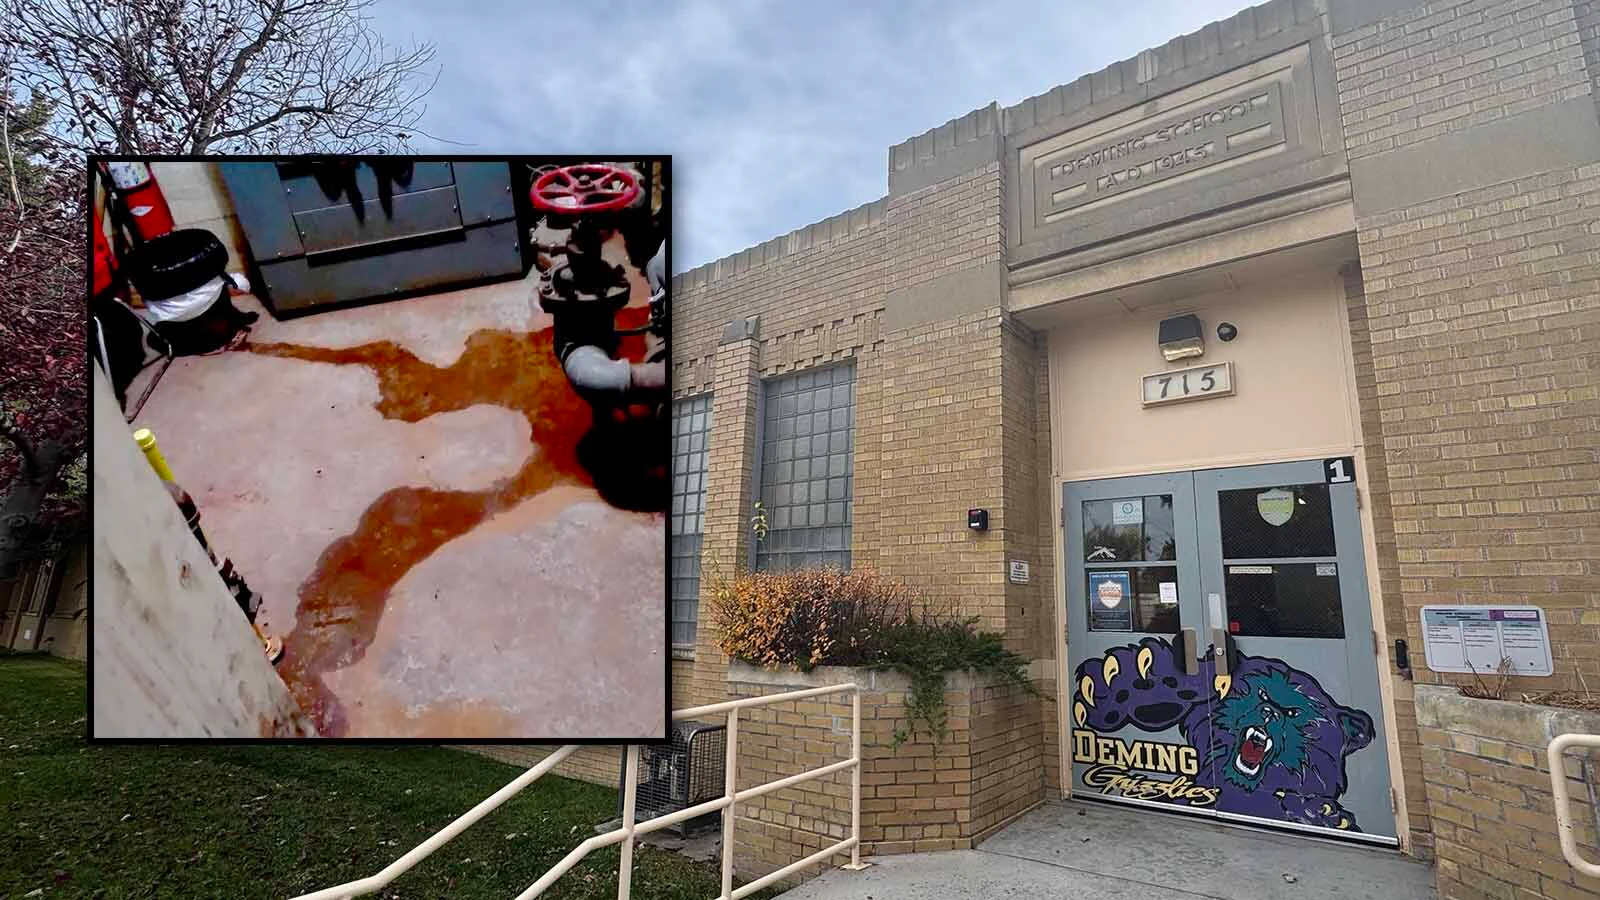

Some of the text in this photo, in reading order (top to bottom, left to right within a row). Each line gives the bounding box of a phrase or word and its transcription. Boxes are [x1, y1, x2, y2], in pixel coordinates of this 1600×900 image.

[1059, 99, 1259, 178] DEMING SCHOOL
[1159, 370, 1215, 398] 715
[1329, 460, 1351, 483] 1
[1073, 730, 1198, 775] DEMING
[1083, 764, 1220, 805] Grizzlies
